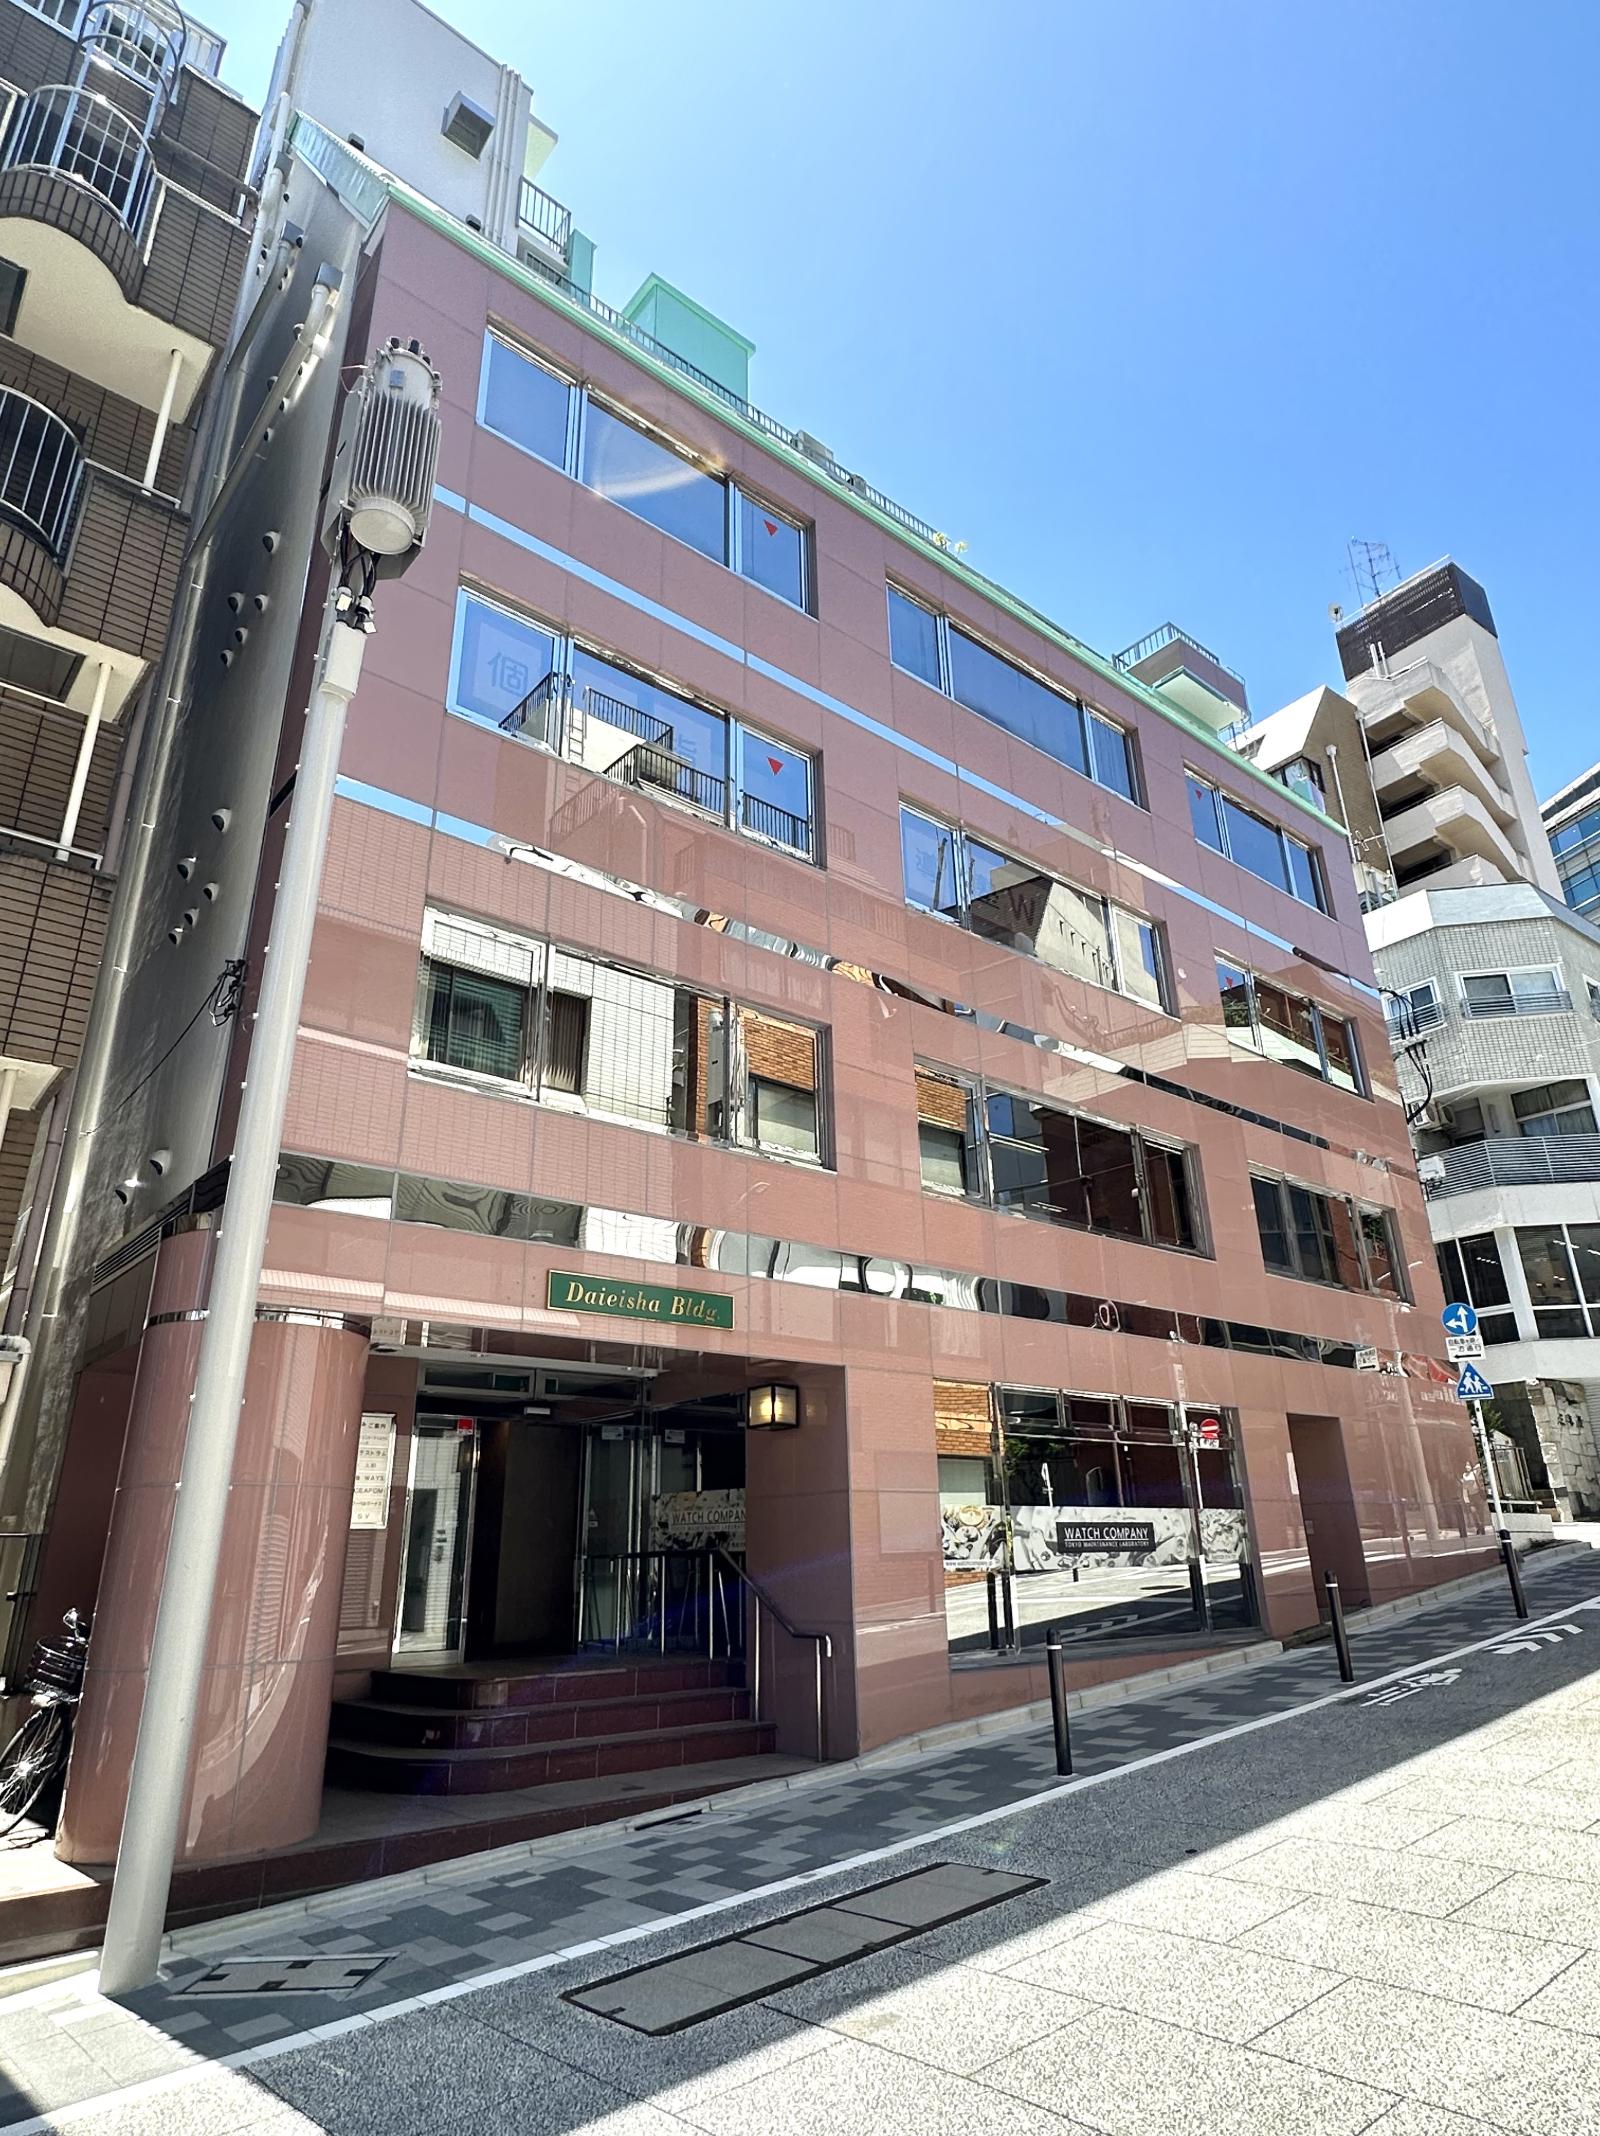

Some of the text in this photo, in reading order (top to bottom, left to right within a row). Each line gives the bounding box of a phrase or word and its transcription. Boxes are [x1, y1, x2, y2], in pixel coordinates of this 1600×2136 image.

[487, 651, 529, 698] 個
[566, 1281, 661, 1313] Daieisha
[672, 1509, 746, 1524] WATCH COMPAN
[1064, 1527, 1149, 1539] WATCH COMPANY
